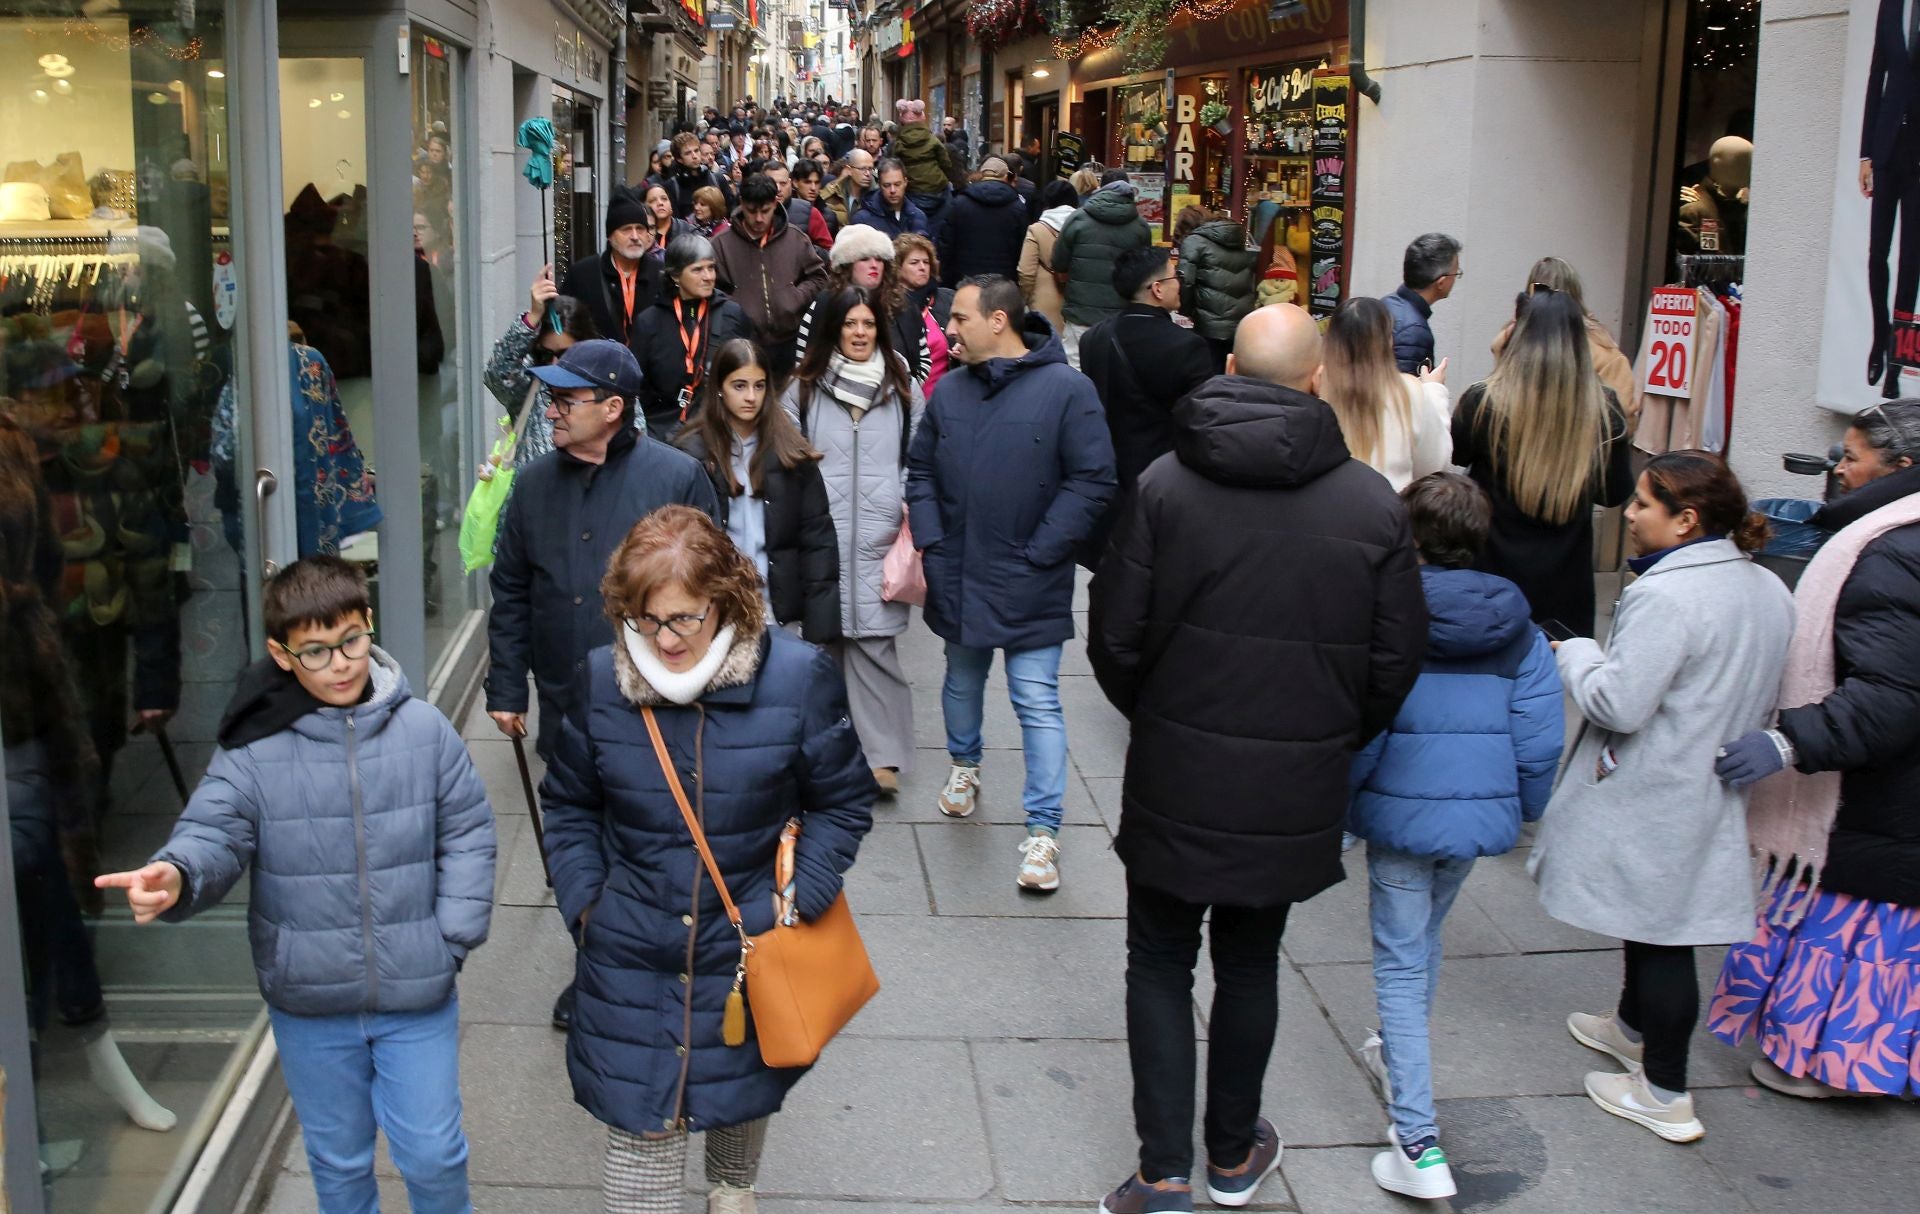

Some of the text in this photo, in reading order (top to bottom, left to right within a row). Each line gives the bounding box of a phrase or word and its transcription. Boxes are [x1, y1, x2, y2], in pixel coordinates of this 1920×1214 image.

[1316, 103, 1346, 122] CERVEZA
[1174, 94, 1197, 181] BAR
[1653, 293, 1695, 312] OFERTA
[1653, 319, 1691, 336] TODO
[1648, 340, 1686, 389] 20
